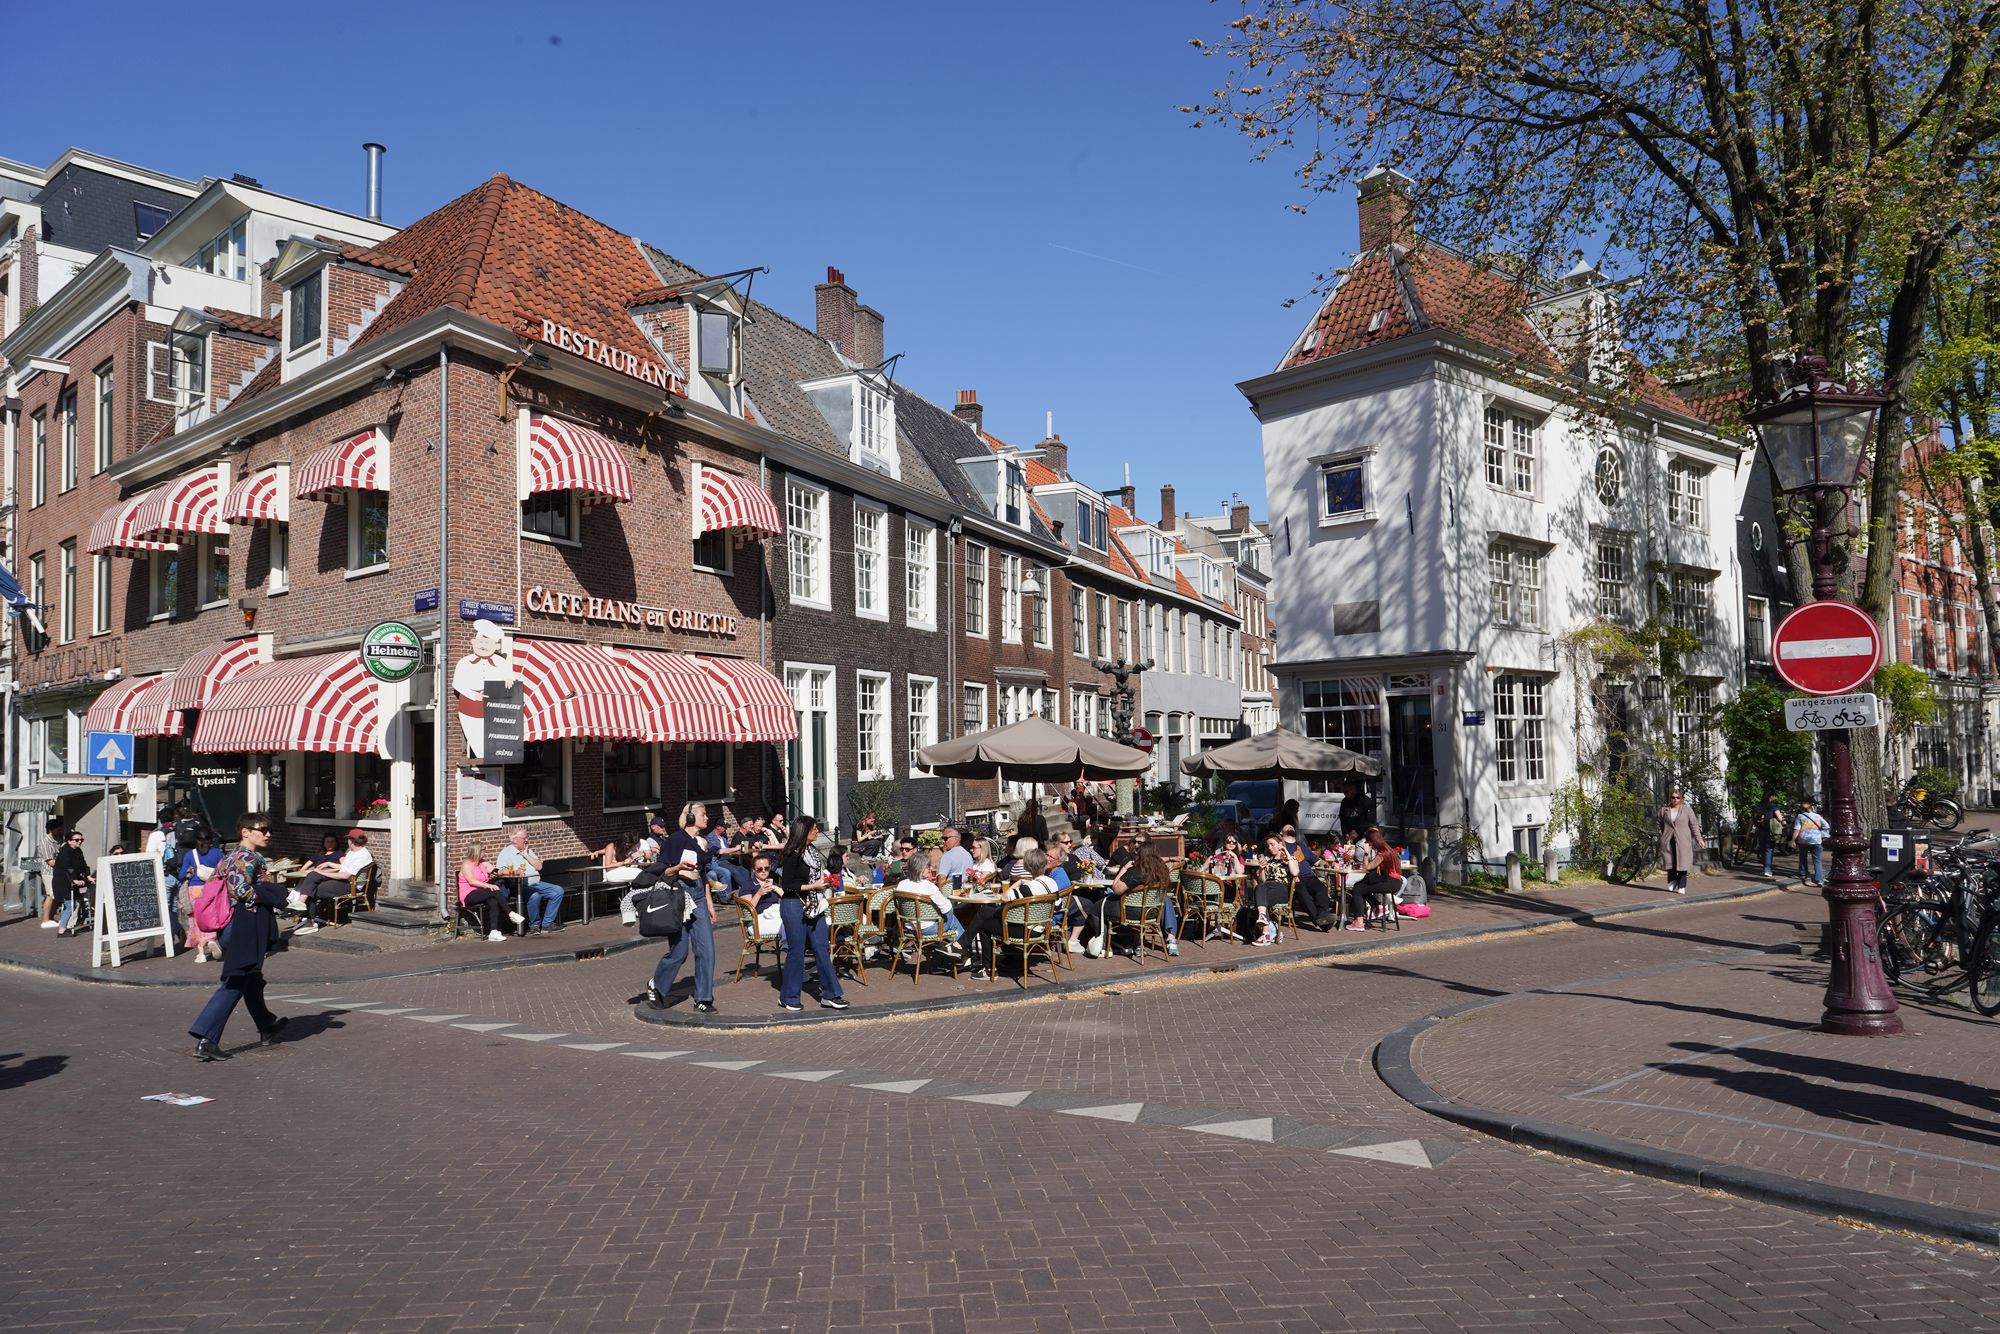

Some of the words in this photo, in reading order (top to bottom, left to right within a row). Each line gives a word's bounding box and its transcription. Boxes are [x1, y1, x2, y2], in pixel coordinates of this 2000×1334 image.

[541, 318, 682, 393] RESTAURANT
[462, 601, 480, 610] TWEEDE
[526, 587, 584, 617] CAFE
[588, 596, 641, 624] HANS
[646, 610, 665, 627] en
[668, 608, 737, 636] GRIETJE
[462, 608, 478, 617] STRAAT
[370, 645, 418, 658] Heineken
[1792, 695, 1865, 708] uitgezonderd
[197, 776, 236, 788] Upstairs
